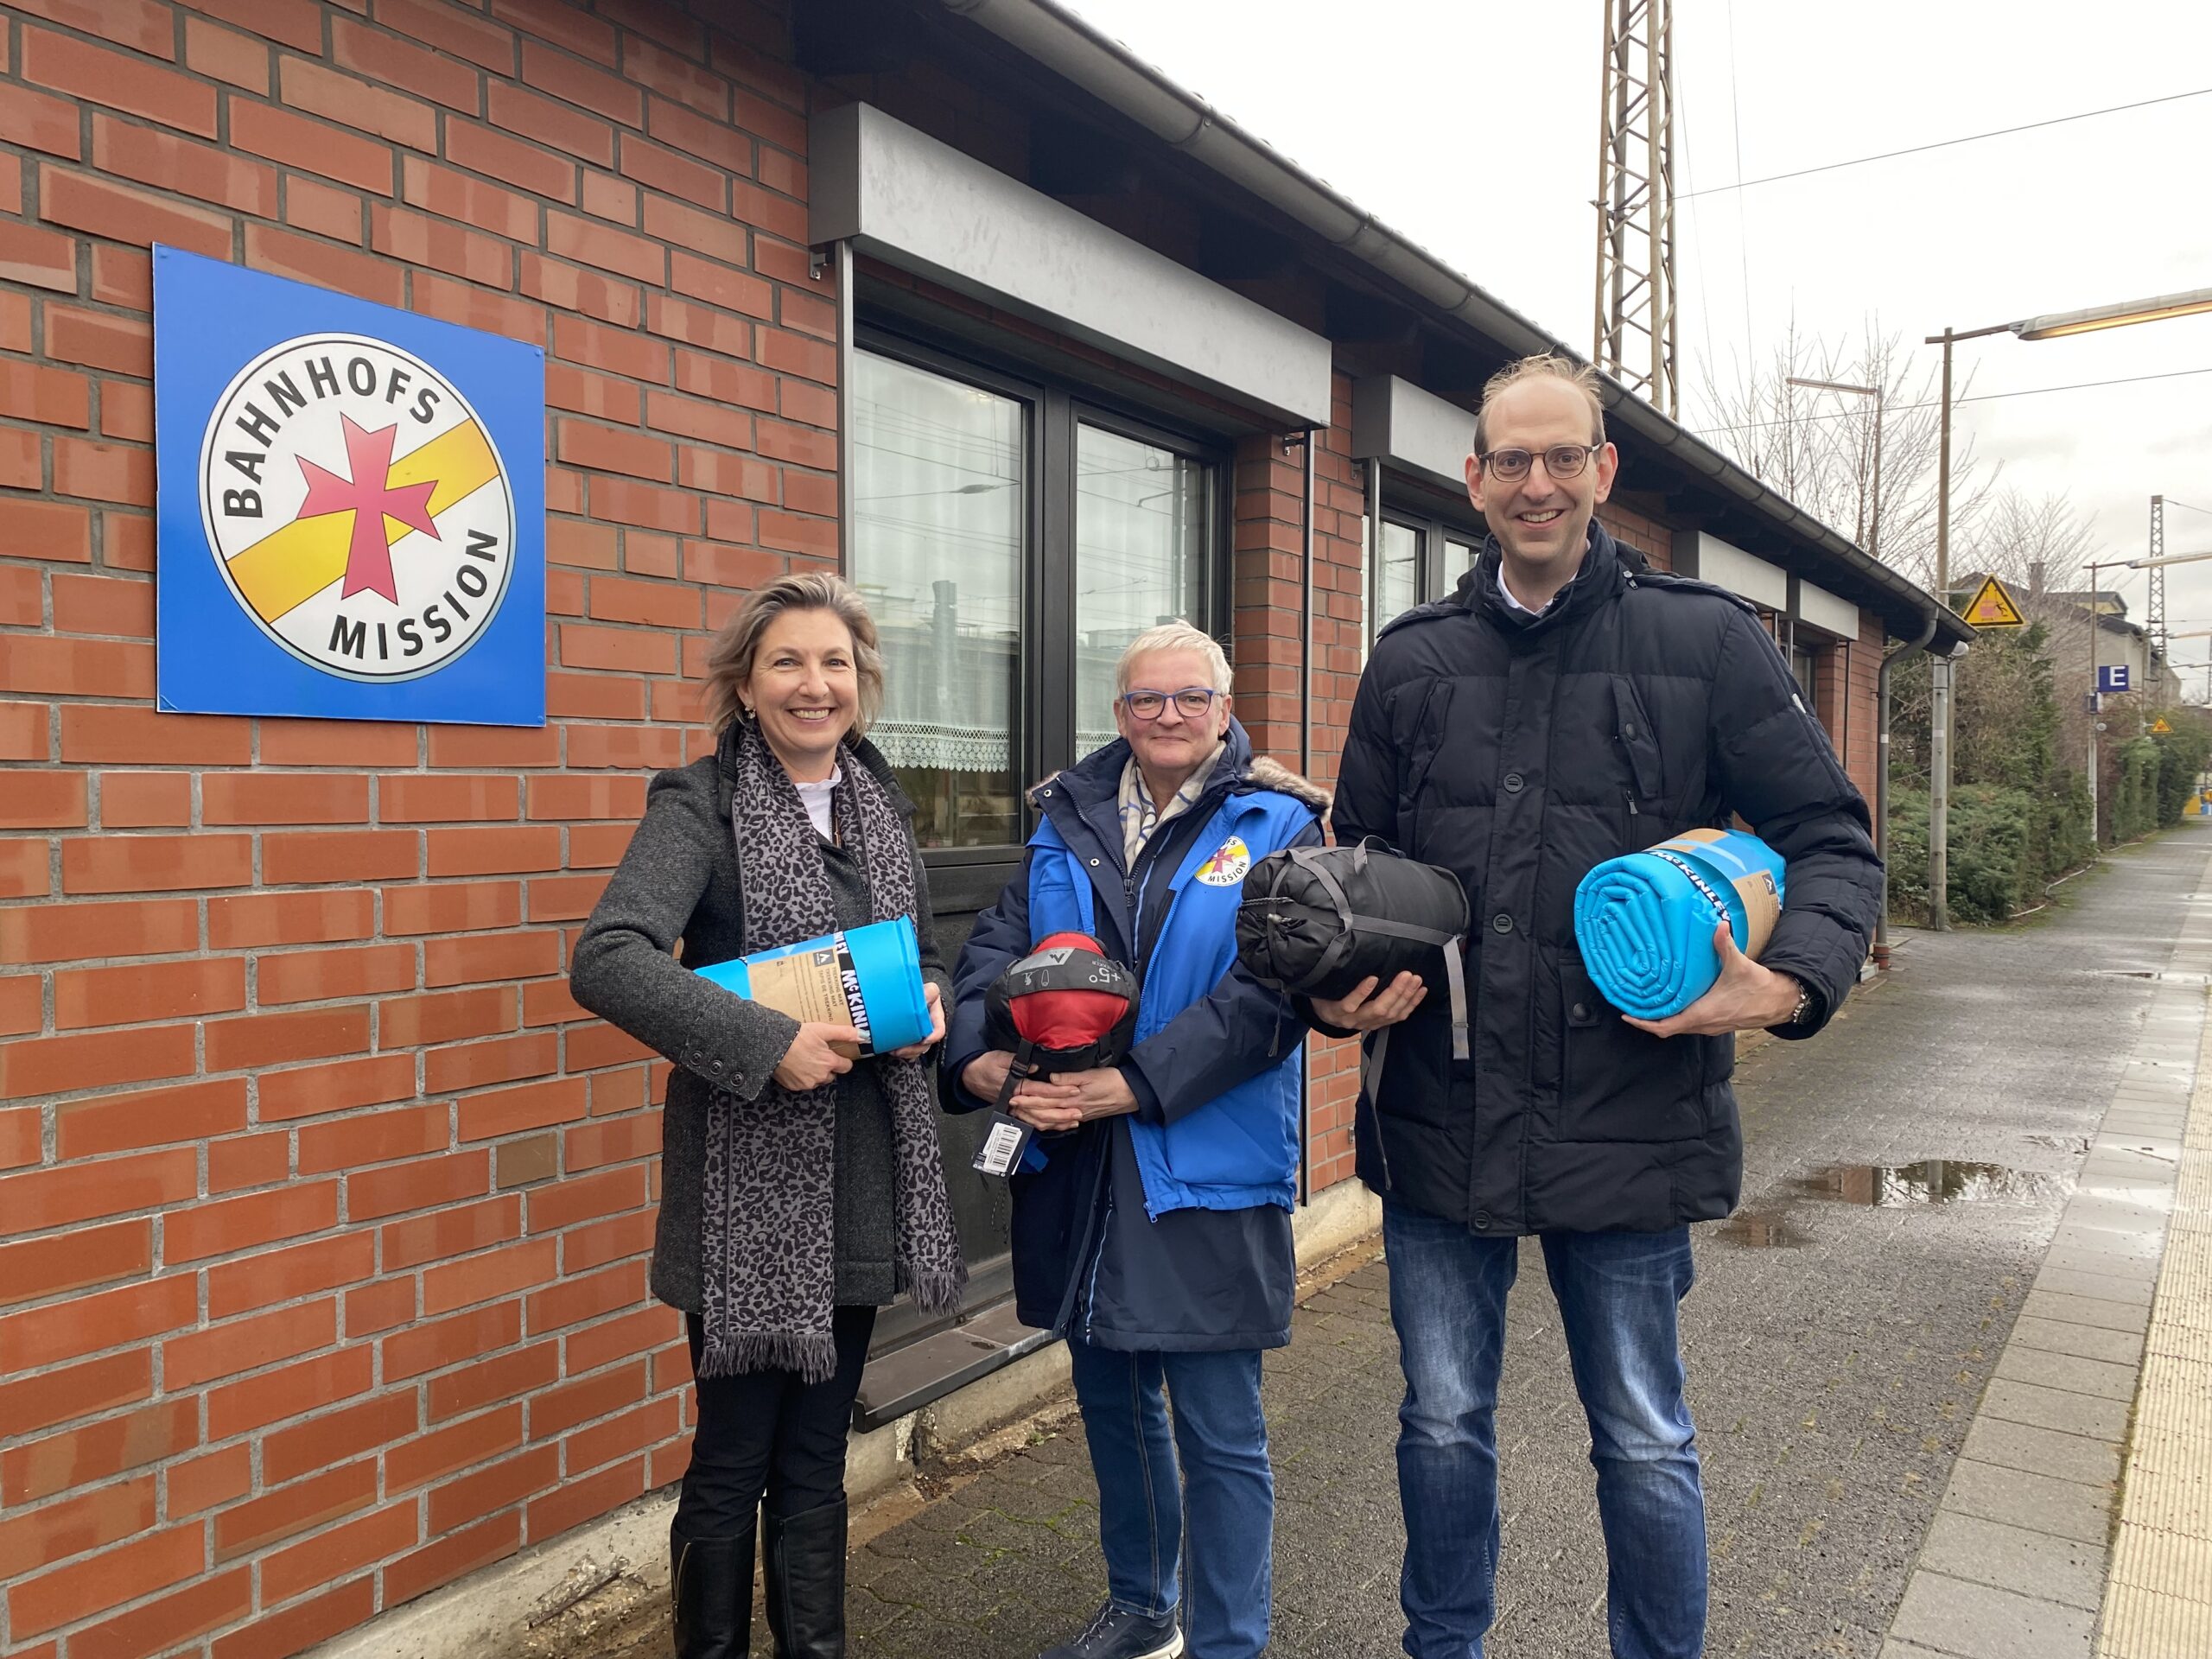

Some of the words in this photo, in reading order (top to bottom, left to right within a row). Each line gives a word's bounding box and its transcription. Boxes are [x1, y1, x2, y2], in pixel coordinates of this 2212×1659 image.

[223, 355, 442, 519] BAHNHOFS
[327, 528, 499, 661] MISSION
[2109, 665, 2126, 686] E
[1207, 860, 1247, 883] MISSION
